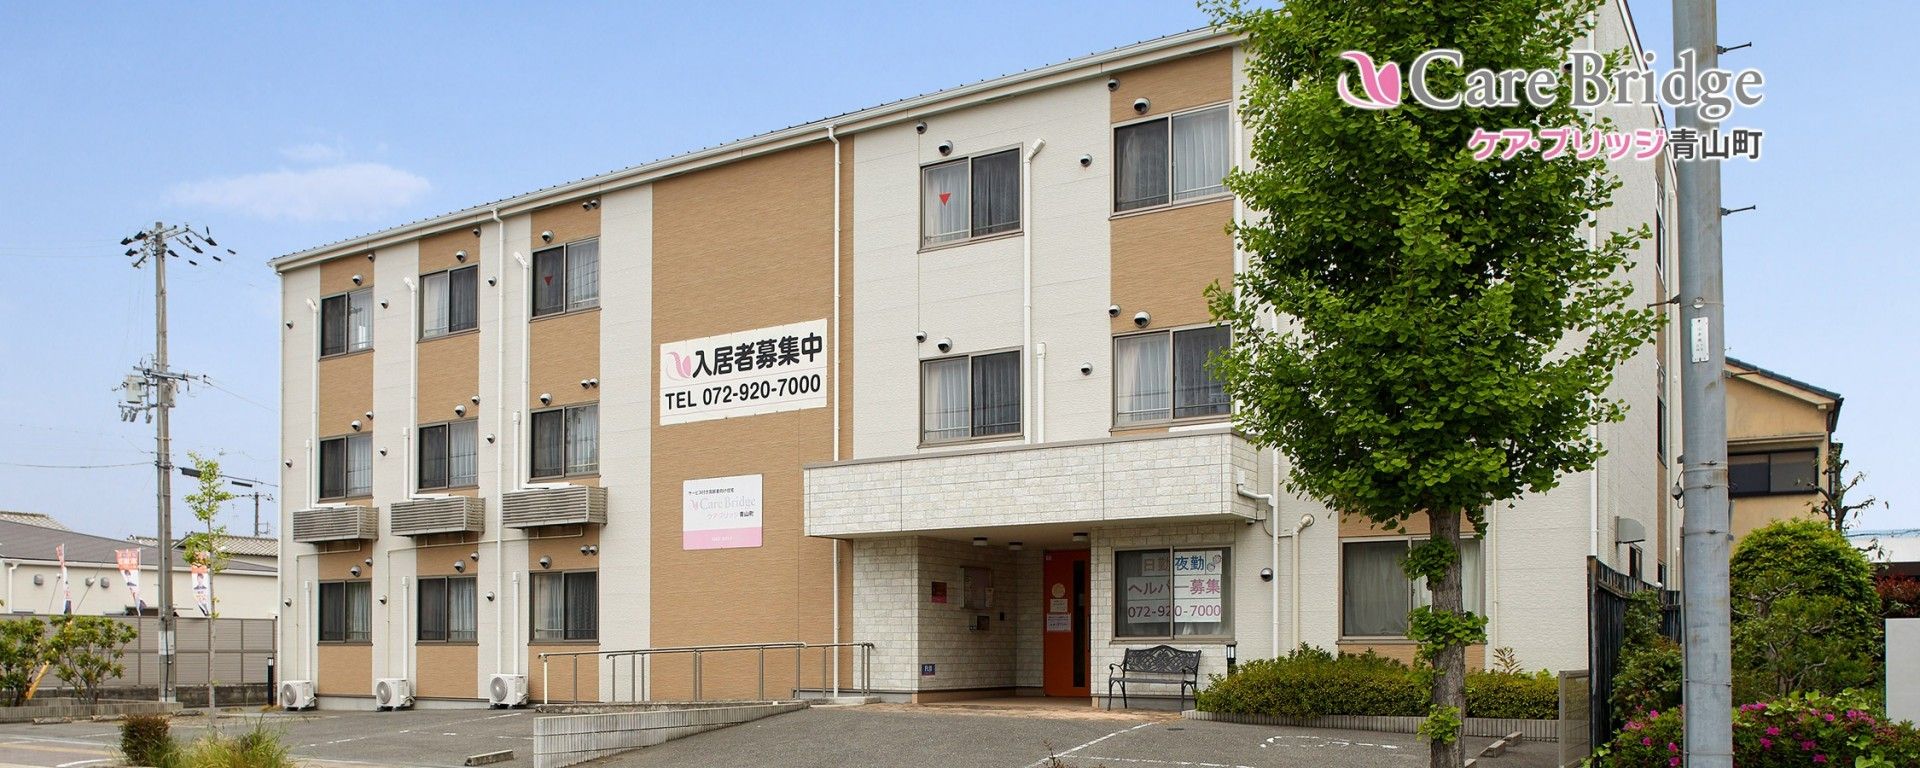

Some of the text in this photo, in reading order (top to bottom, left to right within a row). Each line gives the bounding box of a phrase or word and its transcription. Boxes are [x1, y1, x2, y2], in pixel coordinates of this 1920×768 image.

[692, 332, 823, 378] 入居者募集中
[665, 374, 821, 410] TEL 072-920-7000
[1128, 604, 1221, 618] 072-920-7000
